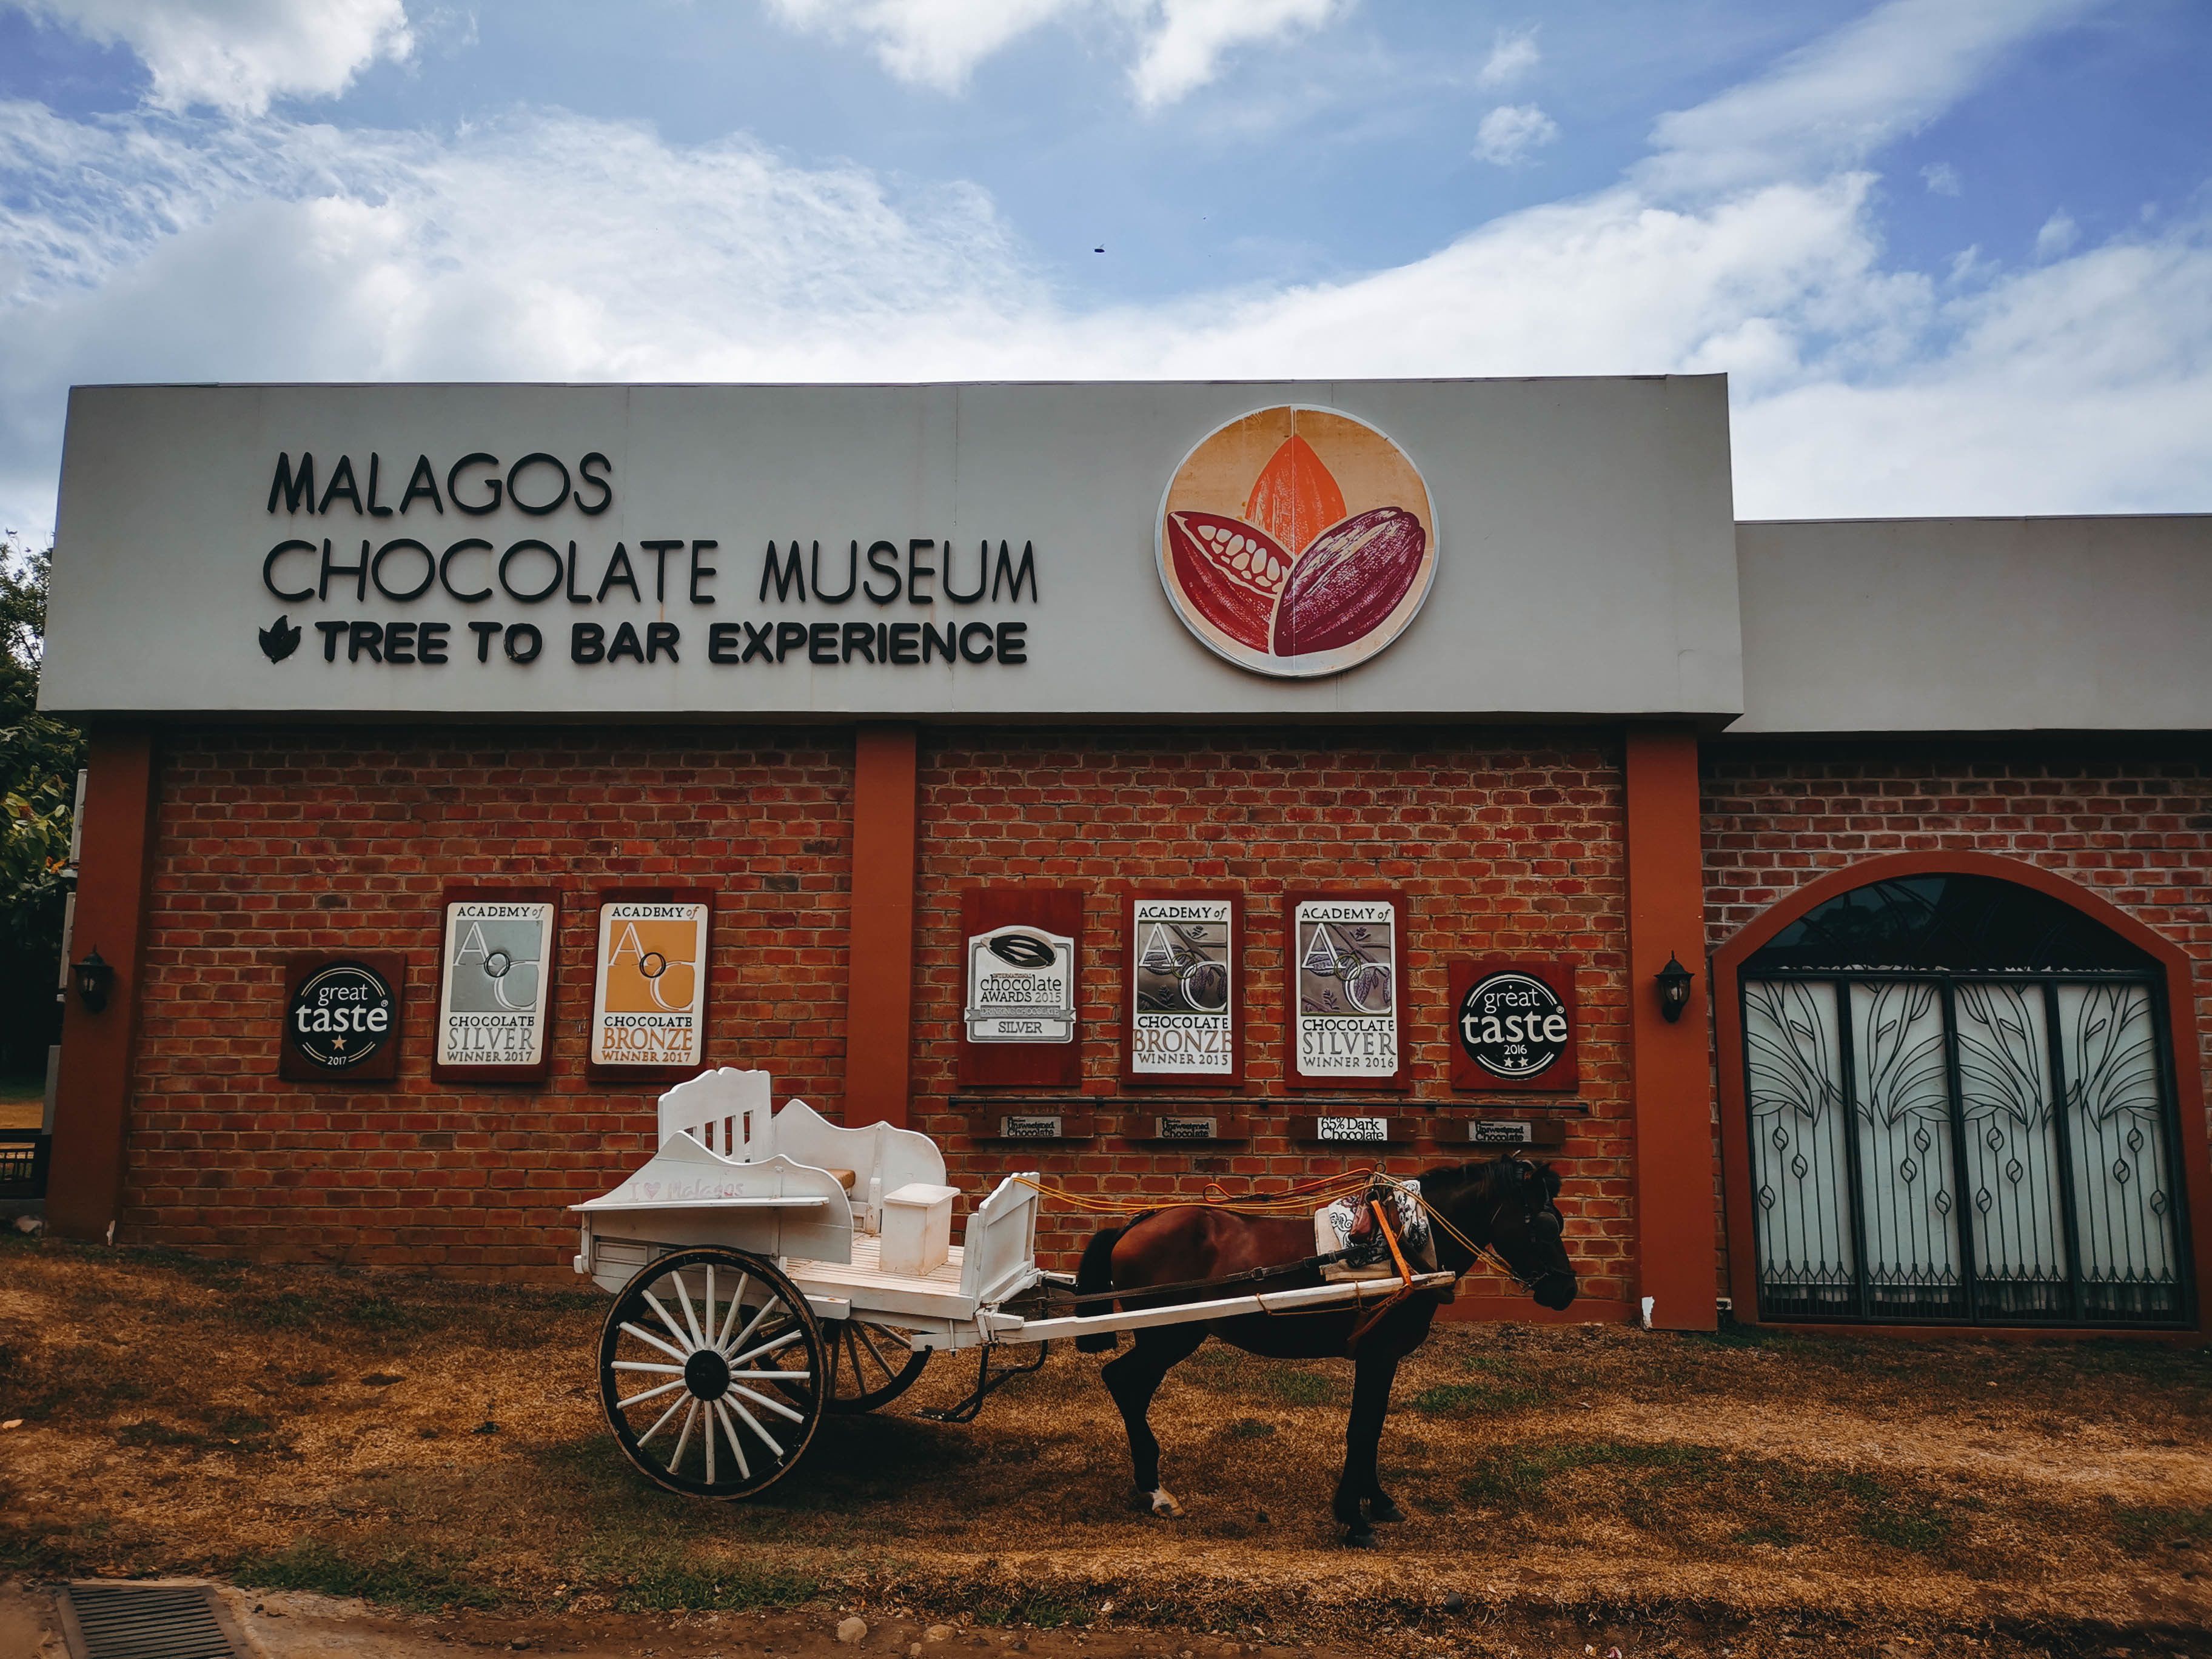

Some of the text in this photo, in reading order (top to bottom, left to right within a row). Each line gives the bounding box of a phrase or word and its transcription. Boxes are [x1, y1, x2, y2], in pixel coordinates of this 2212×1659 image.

[267, 452, 612, 515] MALAGOS
[263, 538, 1037, 603] CHOCOLATE MUSEUM
[314, 620, 1028, 664] TREE TO BAR EXPERIENCE
[457, 905, 545, 919] ACADEMY of
[611, 906, 700, 920] ACADEMY of
[1138, 907, 1227, 920] ACADEMY of
[1301, 908, 1390, 922] ACADEMY of
[980, 974, 1062, 991] chocolate
[318, 984, 368, 1007] great
[980, 991, 1062, 1002] AWARDS 2015
[1484, 988, 1540, 1014] great
[449, 1016, 535, 1027] CHOCOLATE
[604, 1016, 692, 1027] CHOCOLATE
[998, 1021, 1043, 1034] SILVER
[1138, 1016, 1228, 1029] CHOCOLATE
[1302, 1019, 1395, 1031] CHOCOLATE
[447, 1027, 535, 1050] SILVER
[602, 1027, 693, 1050] BRONZE
[1133, 1029, 1232, 1053] BRONZE
[1302, 1032, 1396, 1055] SILVER
[1503, 1044, 1527, 1055] 2016
[327, 1056, 347, 1065] 2017
[447, 1051, 533, 1062] WINNER 2017
[602, 1051, 691, 1062] WINNER 2017
[1138, 1053, 1228, 1065] WINNER 2015
[1303, 1056, 1395, 1068] WINNER 2016
[1321, 1117, 1380, 1130] 65% Dark
[1007, 1127, 1054, 1138] Chocolate
[1321, 1128, 1384, 1141] Chocolate
[629, 1182, 640, 1201] I
